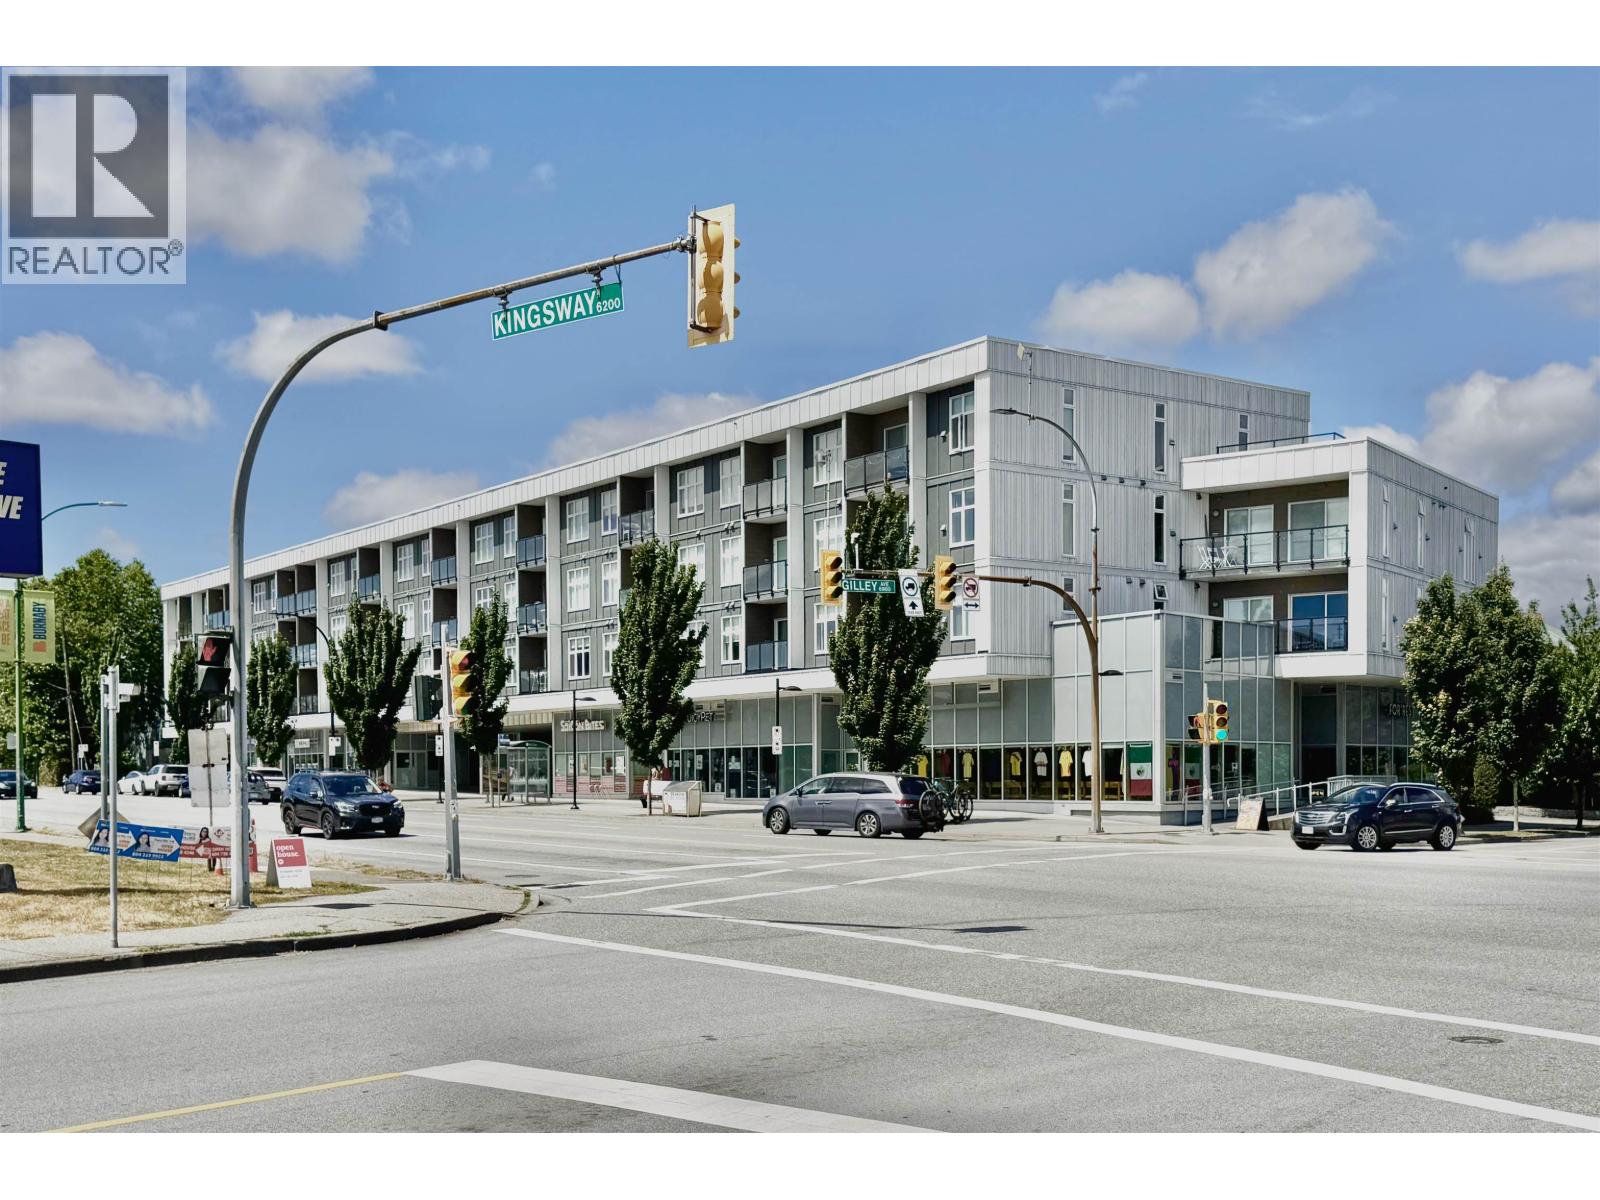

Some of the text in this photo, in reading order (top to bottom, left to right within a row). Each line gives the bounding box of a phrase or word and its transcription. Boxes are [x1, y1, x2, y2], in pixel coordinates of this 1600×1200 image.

[494, 290, 621, 337] KINGSWAY 6200
[842, 580, 878, 592] GILLEY
[32, 601, 47, 640] BURNABY
